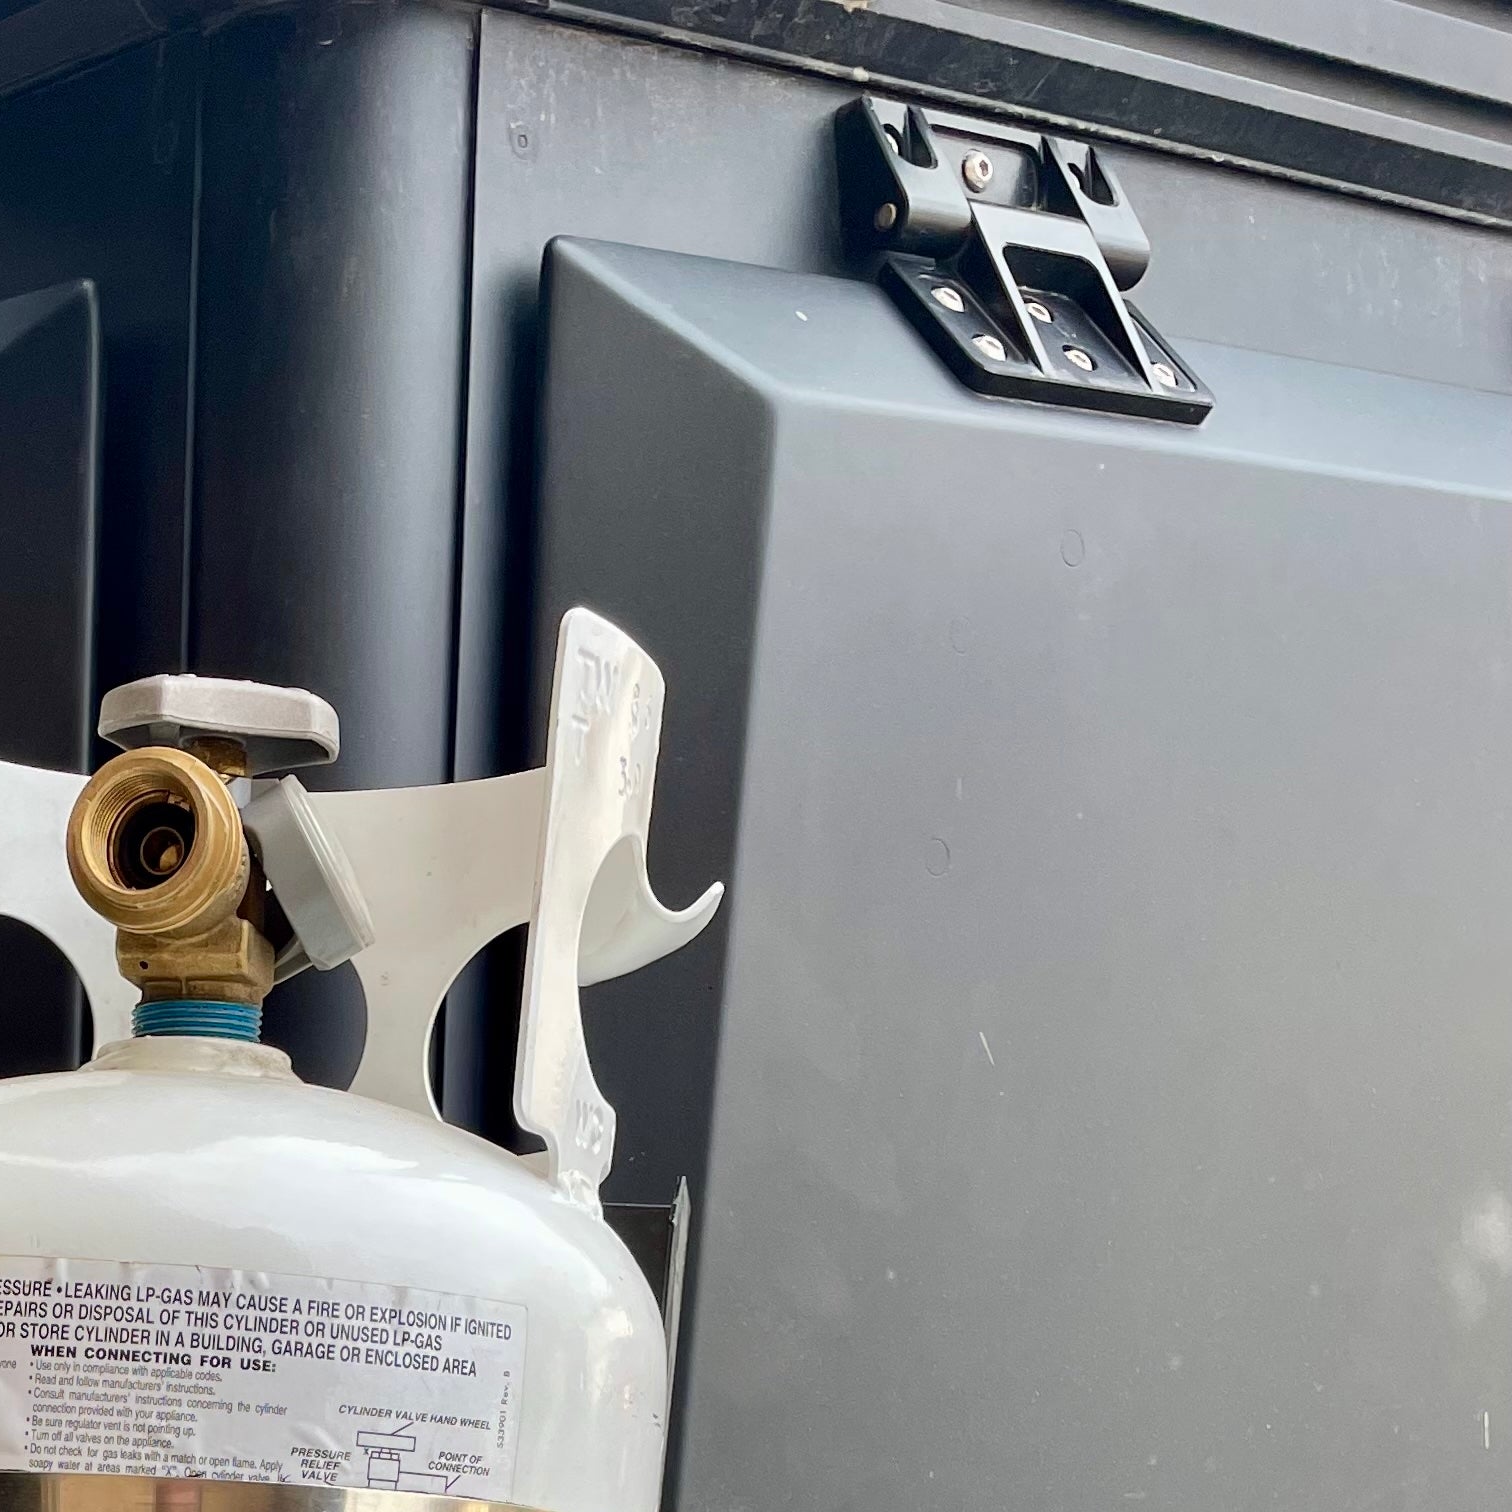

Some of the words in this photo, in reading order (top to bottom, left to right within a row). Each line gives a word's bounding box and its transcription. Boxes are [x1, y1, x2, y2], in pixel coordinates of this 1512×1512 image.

[64, 1282, 131, 1301] LEAKING
[136, 1286, 193, 1305] LP-GAS
[198, 1290, 231, 1308] MAY
[236, 1293, 288, 1313] CAUSE
[292, 1298, 302, 1314] A
[307, 1300, 340, 1318] FIRE
[344, 1303, 365, 1321] OR
[369, 1306, 446, 1330] EXPLOSION
[450, 1316, 461, 1332] IF
[464, 1318, 511, 1340] IGNITED
[52, 1303, 73, 1319] OR
[78, 1304, 154, 1324] DISPOSAL
[159, 1310, 179, 1325] OF
[187, 1312, 218, 1329] THIS
[223, 1316, 299, 1335] CYLINDER
[304, 1323, 325, 1338] OR
[330, 1325, 388, 1344] UNUSED
[393, 1331, 442, 1351] LP-GAS
[20, 1323, 69, 1340] STORE
[74, 1325, 150, 1345] CYLINDER
[155, 1330, 170, 1346] IN
[174, 1331, 184, 1347] A
[190, 1332, 266, 1355] BUILDING,
[271, 1339, 335, 1360] GARAGE
[340, 1345, 360, 1362] OR
[364, 1348, 438, 1371] ENCLOSED
[442, 1357, 476, 1377] AREA
[30, 1345, 76, 1358] WHEN
[84, 1347, 191, 1365] CONNECTING
[200, 1355, 231, 1368] FOR
[240, 1358, 276, 1372] USE:
[35, 1359, 52, 1370] Use
[53, 1361, 71, 1374] only
[72, 1361, 80, 1372] in
[82, 1363, 129, 1375] compliance
[131, 1365, 148, 1376] with
[150, 1366, 192, 1380] applicable
[34, 1374, 56, 1385] Read
[58, 1375, 74, 1386] and
[76, 1375, 100, 1387] follow
[32, 1403, 76, 1414] connection
[78, 1405, 114, 1417] provided
[116, 1407, 132, 1417] with
[134, 1409, 154, 1421] your
[33, 1387, 64, 1399] Consult
[134, 1394, 182, 1407] instructions
[186, 1399, 232, 1413] concerning
[237, 1401, 250, 1412] the
[254, 1403, 287, 1416] cylinder
[31, 1415, 42, 1426] Be
[44, 1418, 62, 1428] sure
[64, 1418, 101, 1431] regulator
[103, 1421, 121, 1431] vent
[122, 1421, 130, 1432] is
[132, 1422, 145, 1432] not
[147, 1424, 180, 1438] pointing
[338, 1404, 392, 1418] CYLINDER
[396, 1410, 428, 1422] VALVE
[430, 1414, 458, 1426] HAND
[460, 1418, 491, 1430] WHEEL
[51, 1430, 62, 1441] off
[63, 1431, 73, 1442] all
[75, 1433, 101, 1444] valves
[103, 1435, 114, 1444] on
[116, 1435, 129, 1446] the
[30, 1442, 41, 1454] Do
[43, 1445, 56, 1455] not
[58, 1444, 82, 1456] check
[87, 1446, 98, 1457] for
[102, 1449, 118, 1460] gas
[120, 1448, 142, 1460] leaks
[144, 1451, 160, 1461] with
[162, 1453, 168, 1462] a
[170, 1454, 196, 1464] match
[198, 1456, 207, 1465] or
[208, 1457, 230, 1468] open
[259, 1460, 283, 1474] Apply
[290, 1447, 351, 1461] PRESSURE
[438, 1452, 467, 1462] POINT
[469, 1454, 482, 1464] OF
[300, 1460, 341, 1470] RELIEF
[428, 1461, 490, 1476] CONNECTION
[301, 1470, 338, 1482] VALVE
